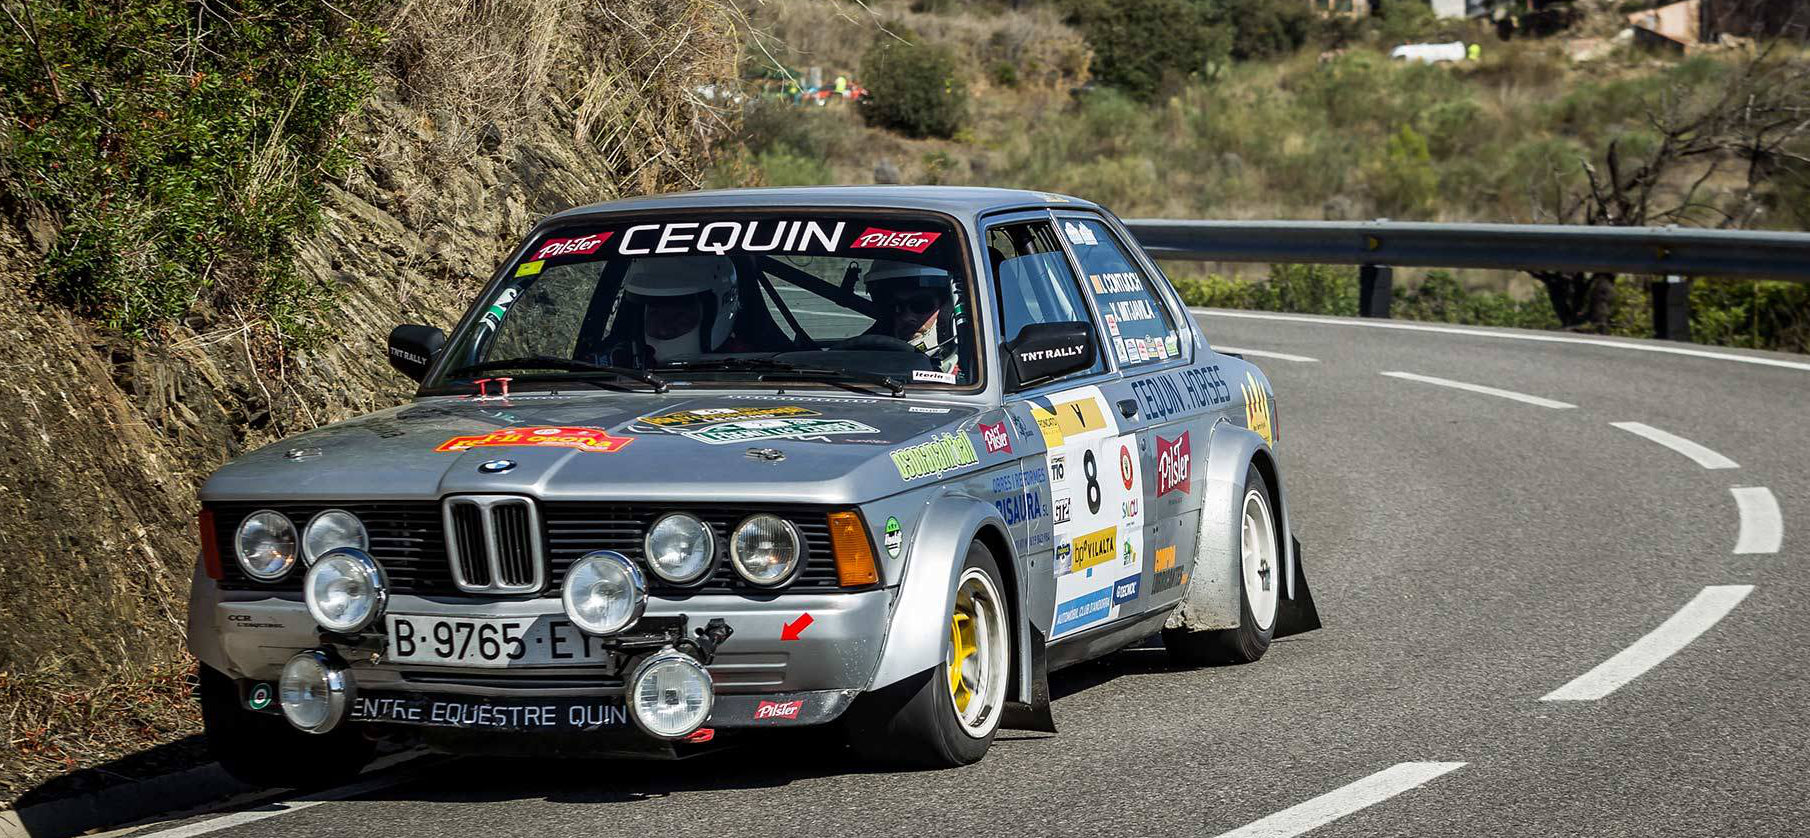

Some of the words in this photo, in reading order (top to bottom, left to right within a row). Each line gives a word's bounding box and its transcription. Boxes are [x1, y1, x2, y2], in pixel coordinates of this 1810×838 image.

[618, 221, 846, 256] CEQUIN
[390, 347, 404, 357] TNT
[404, 350, 428, 366] RALLY
[1020, 350, 1044, 362] TNT
[1045, 345, 1084, 359] RALLY
[1131, 377, 1182, 421] CEQUIN
[1083, 449, 1101, 516] 8
[1088, 537, 1114, 559] VILALTA
[228, 614, 252, 622] CCR
[350, 698, 421, 720] ENTRE
[431, 702, 556, 726] EQUESTRE
